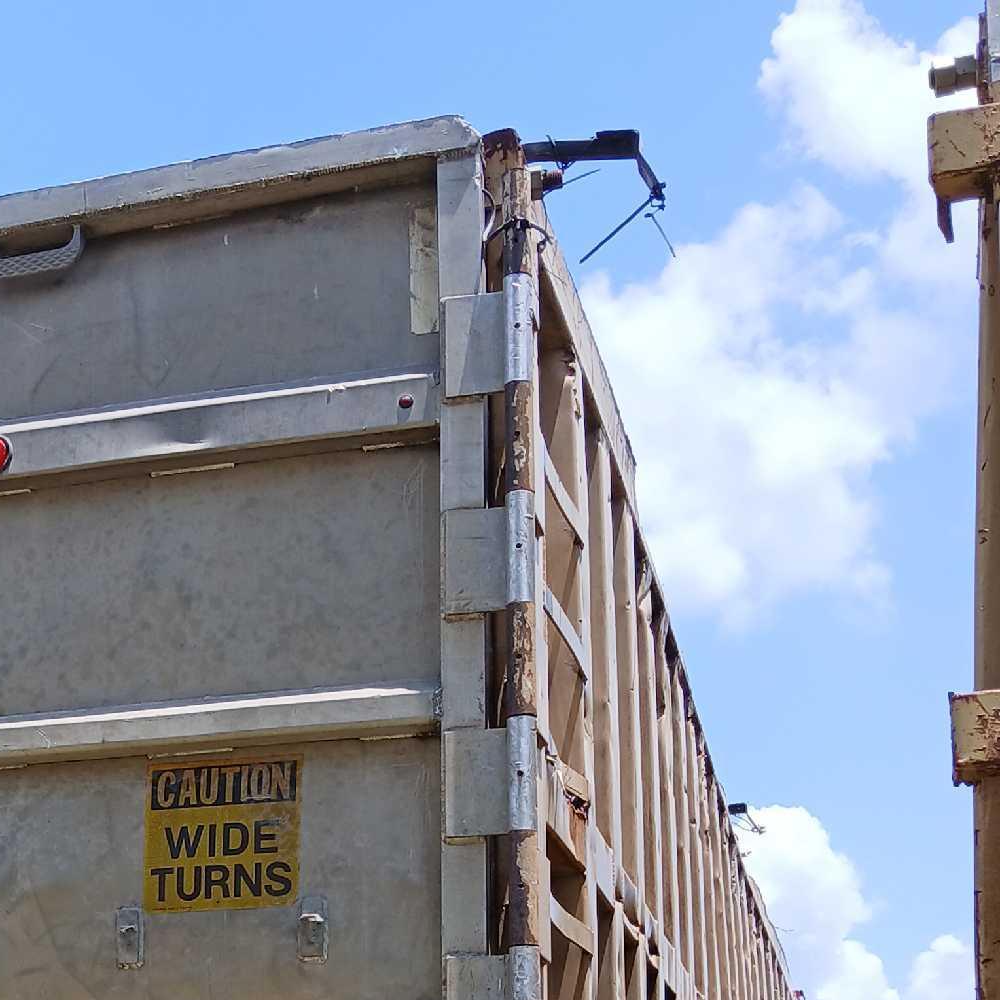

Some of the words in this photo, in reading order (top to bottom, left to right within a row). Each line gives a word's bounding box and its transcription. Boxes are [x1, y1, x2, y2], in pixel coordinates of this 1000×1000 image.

[156, 762, 291, 808] CAUTION
[164, 819, 281, 859] WIDE
[150, 861, 292, 902] TURNS
